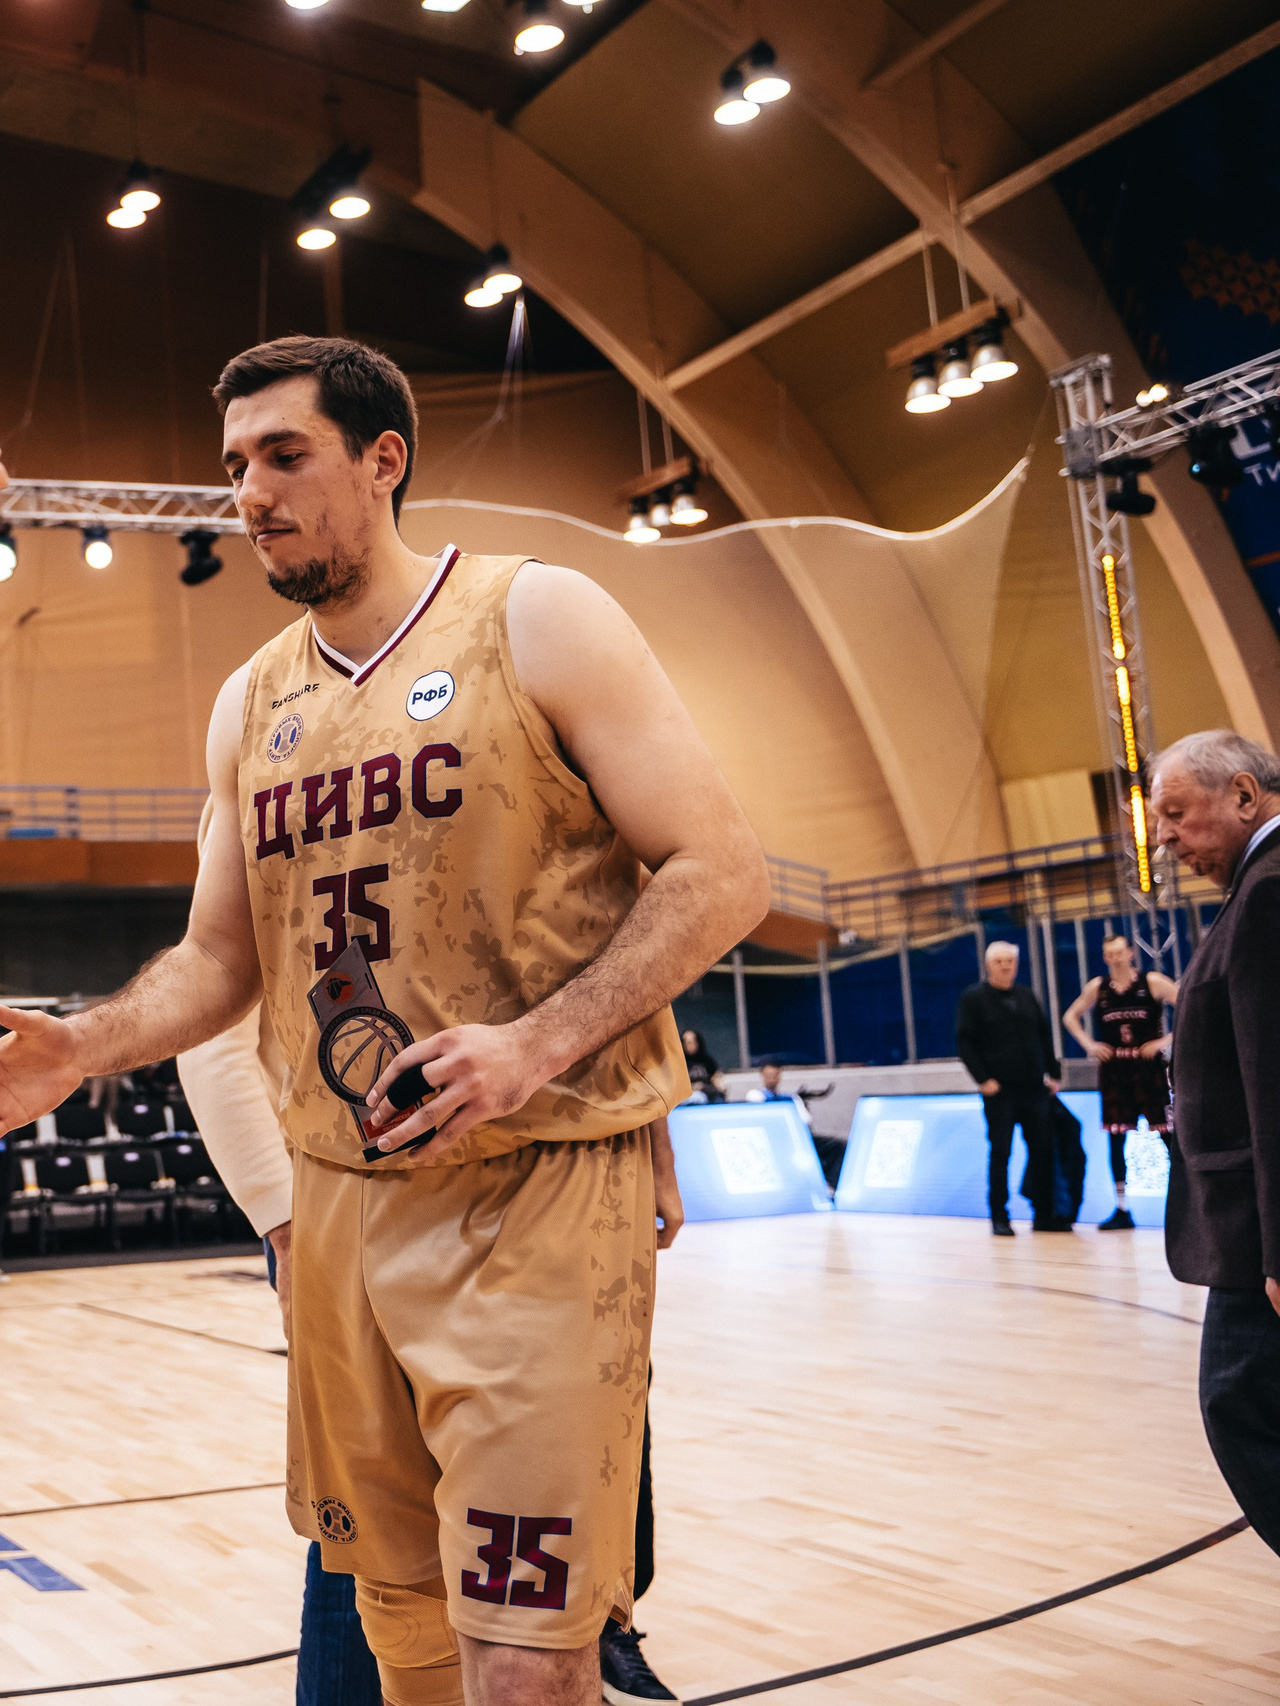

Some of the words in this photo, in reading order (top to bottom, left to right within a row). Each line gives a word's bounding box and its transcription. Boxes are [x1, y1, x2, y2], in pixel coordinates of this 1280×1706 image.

[411, 684, 449, 706] РФБ
[253, 742, 463, 861] ЦИВС
[312, 863, 391, 971] 35
[460, 1507, 572, 1611] 35
